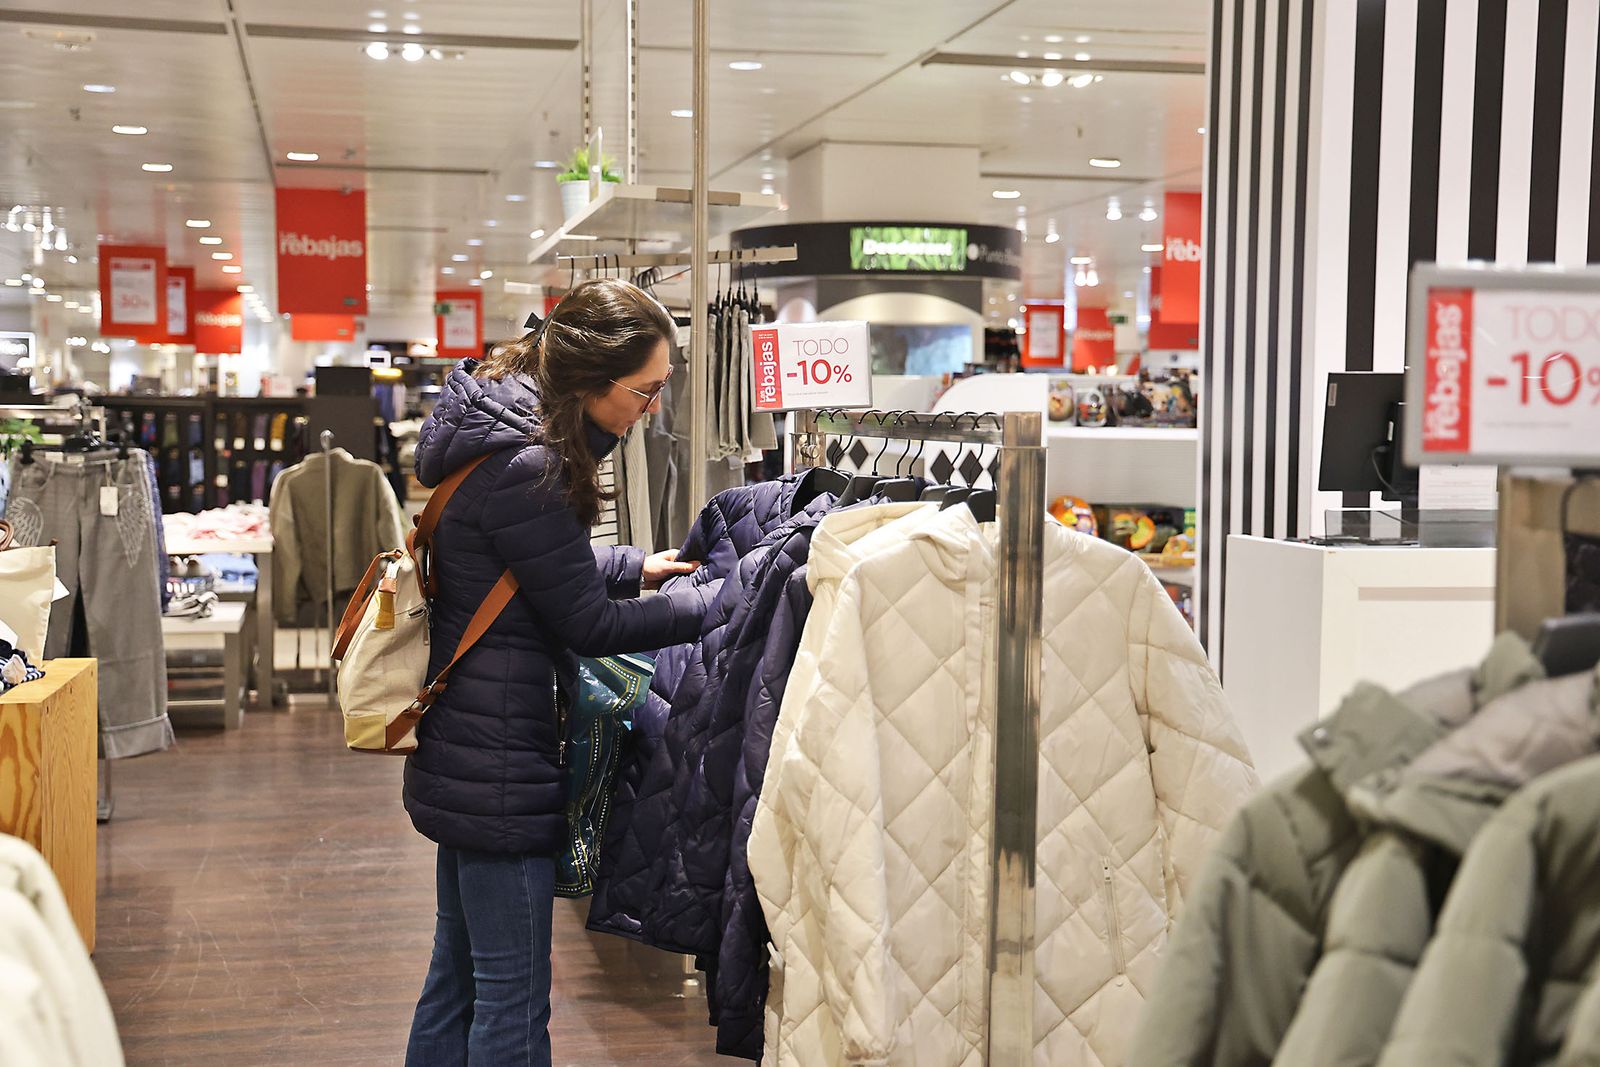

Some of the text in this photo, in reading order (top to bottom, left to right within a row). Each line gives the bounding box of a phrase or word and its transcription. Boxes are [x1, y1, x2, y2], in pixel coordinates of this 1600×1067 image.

[280, 234, 363, 260] rebajas
[792, 337, 849, 356] TODO
[761, 341, 777, 403] rebajas
[786, 358, 852, 385] -10%
[1429, 303, 1466, 438] rebajas
